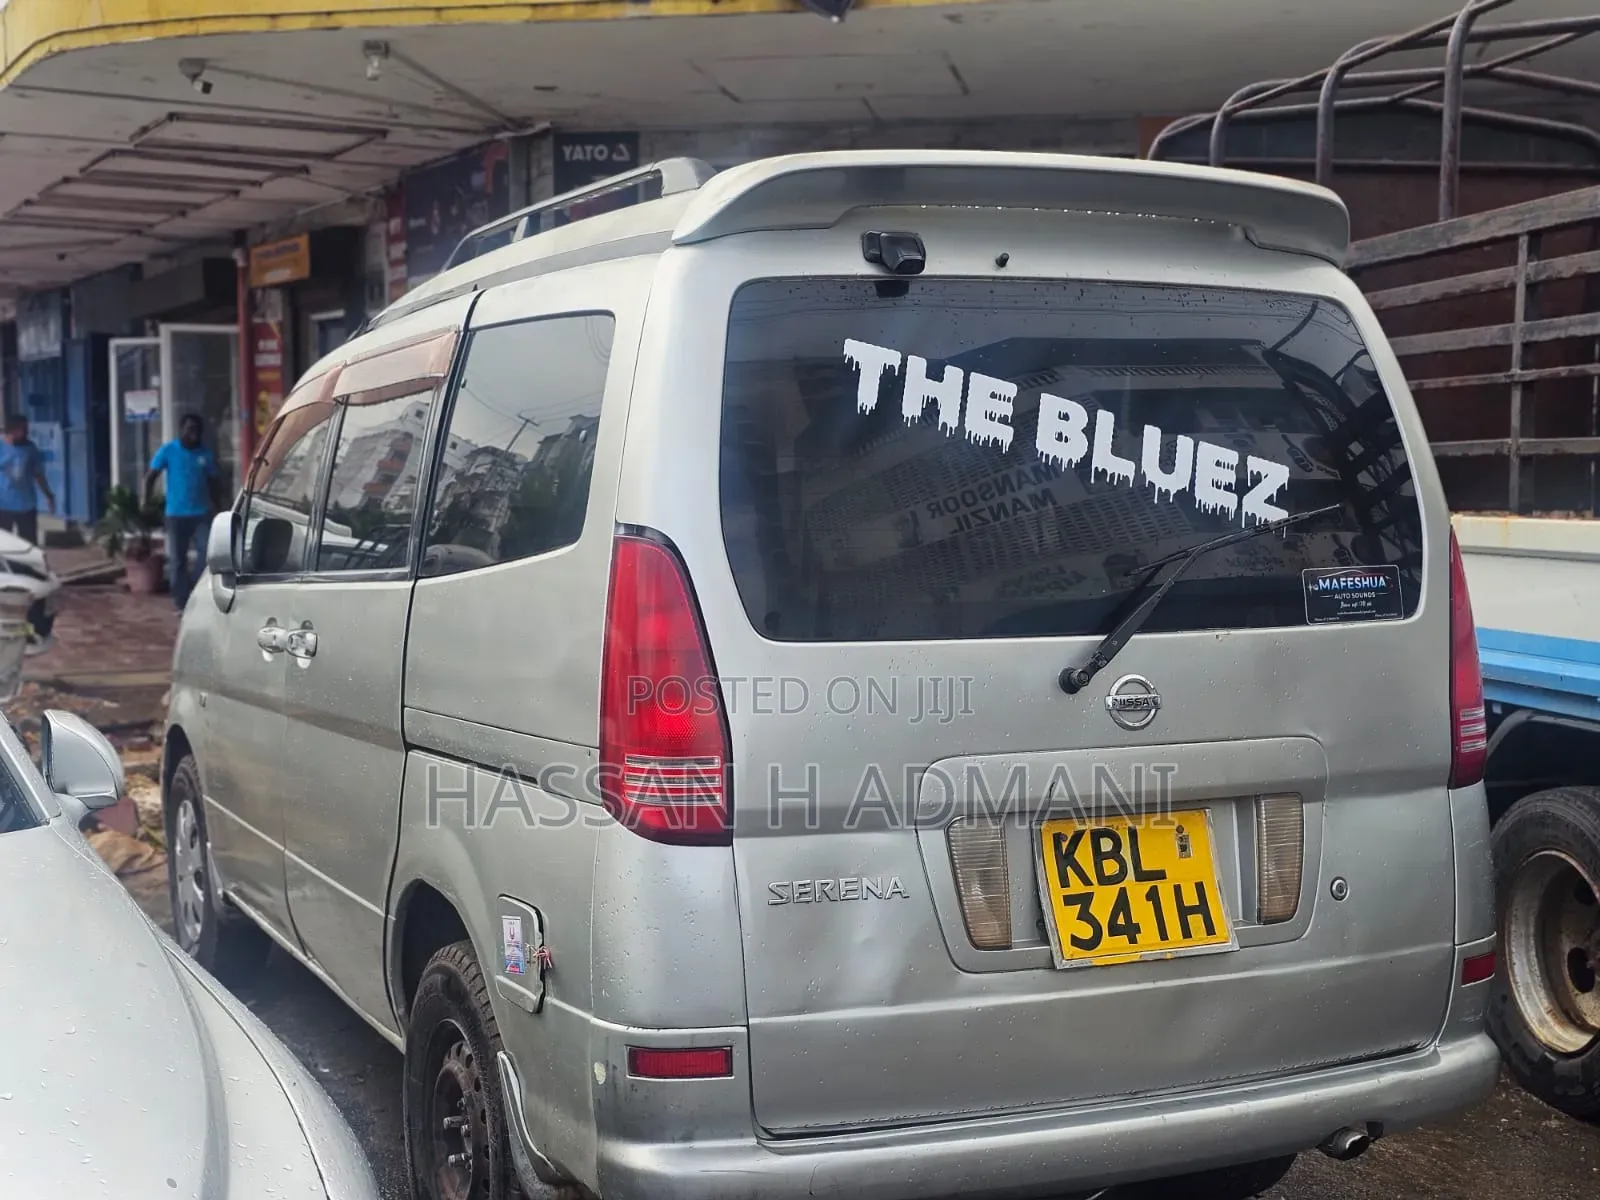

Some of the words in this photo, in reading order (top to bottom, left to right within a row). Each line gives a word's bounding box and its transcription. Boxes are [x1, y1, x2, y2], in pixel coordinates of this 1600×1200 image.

[562, 144, 609, 162] YATO
[843, 338, 1018, 454] THE
[1035, 393, 1291, 538] BLUEZ
[1318, 576, 1386, 591] MAFESHUA
[1053, 826, 1167, 888] KBL
[768, 876, 910, 905] SERENA
[1062, 881, 1217, 951] 341H
